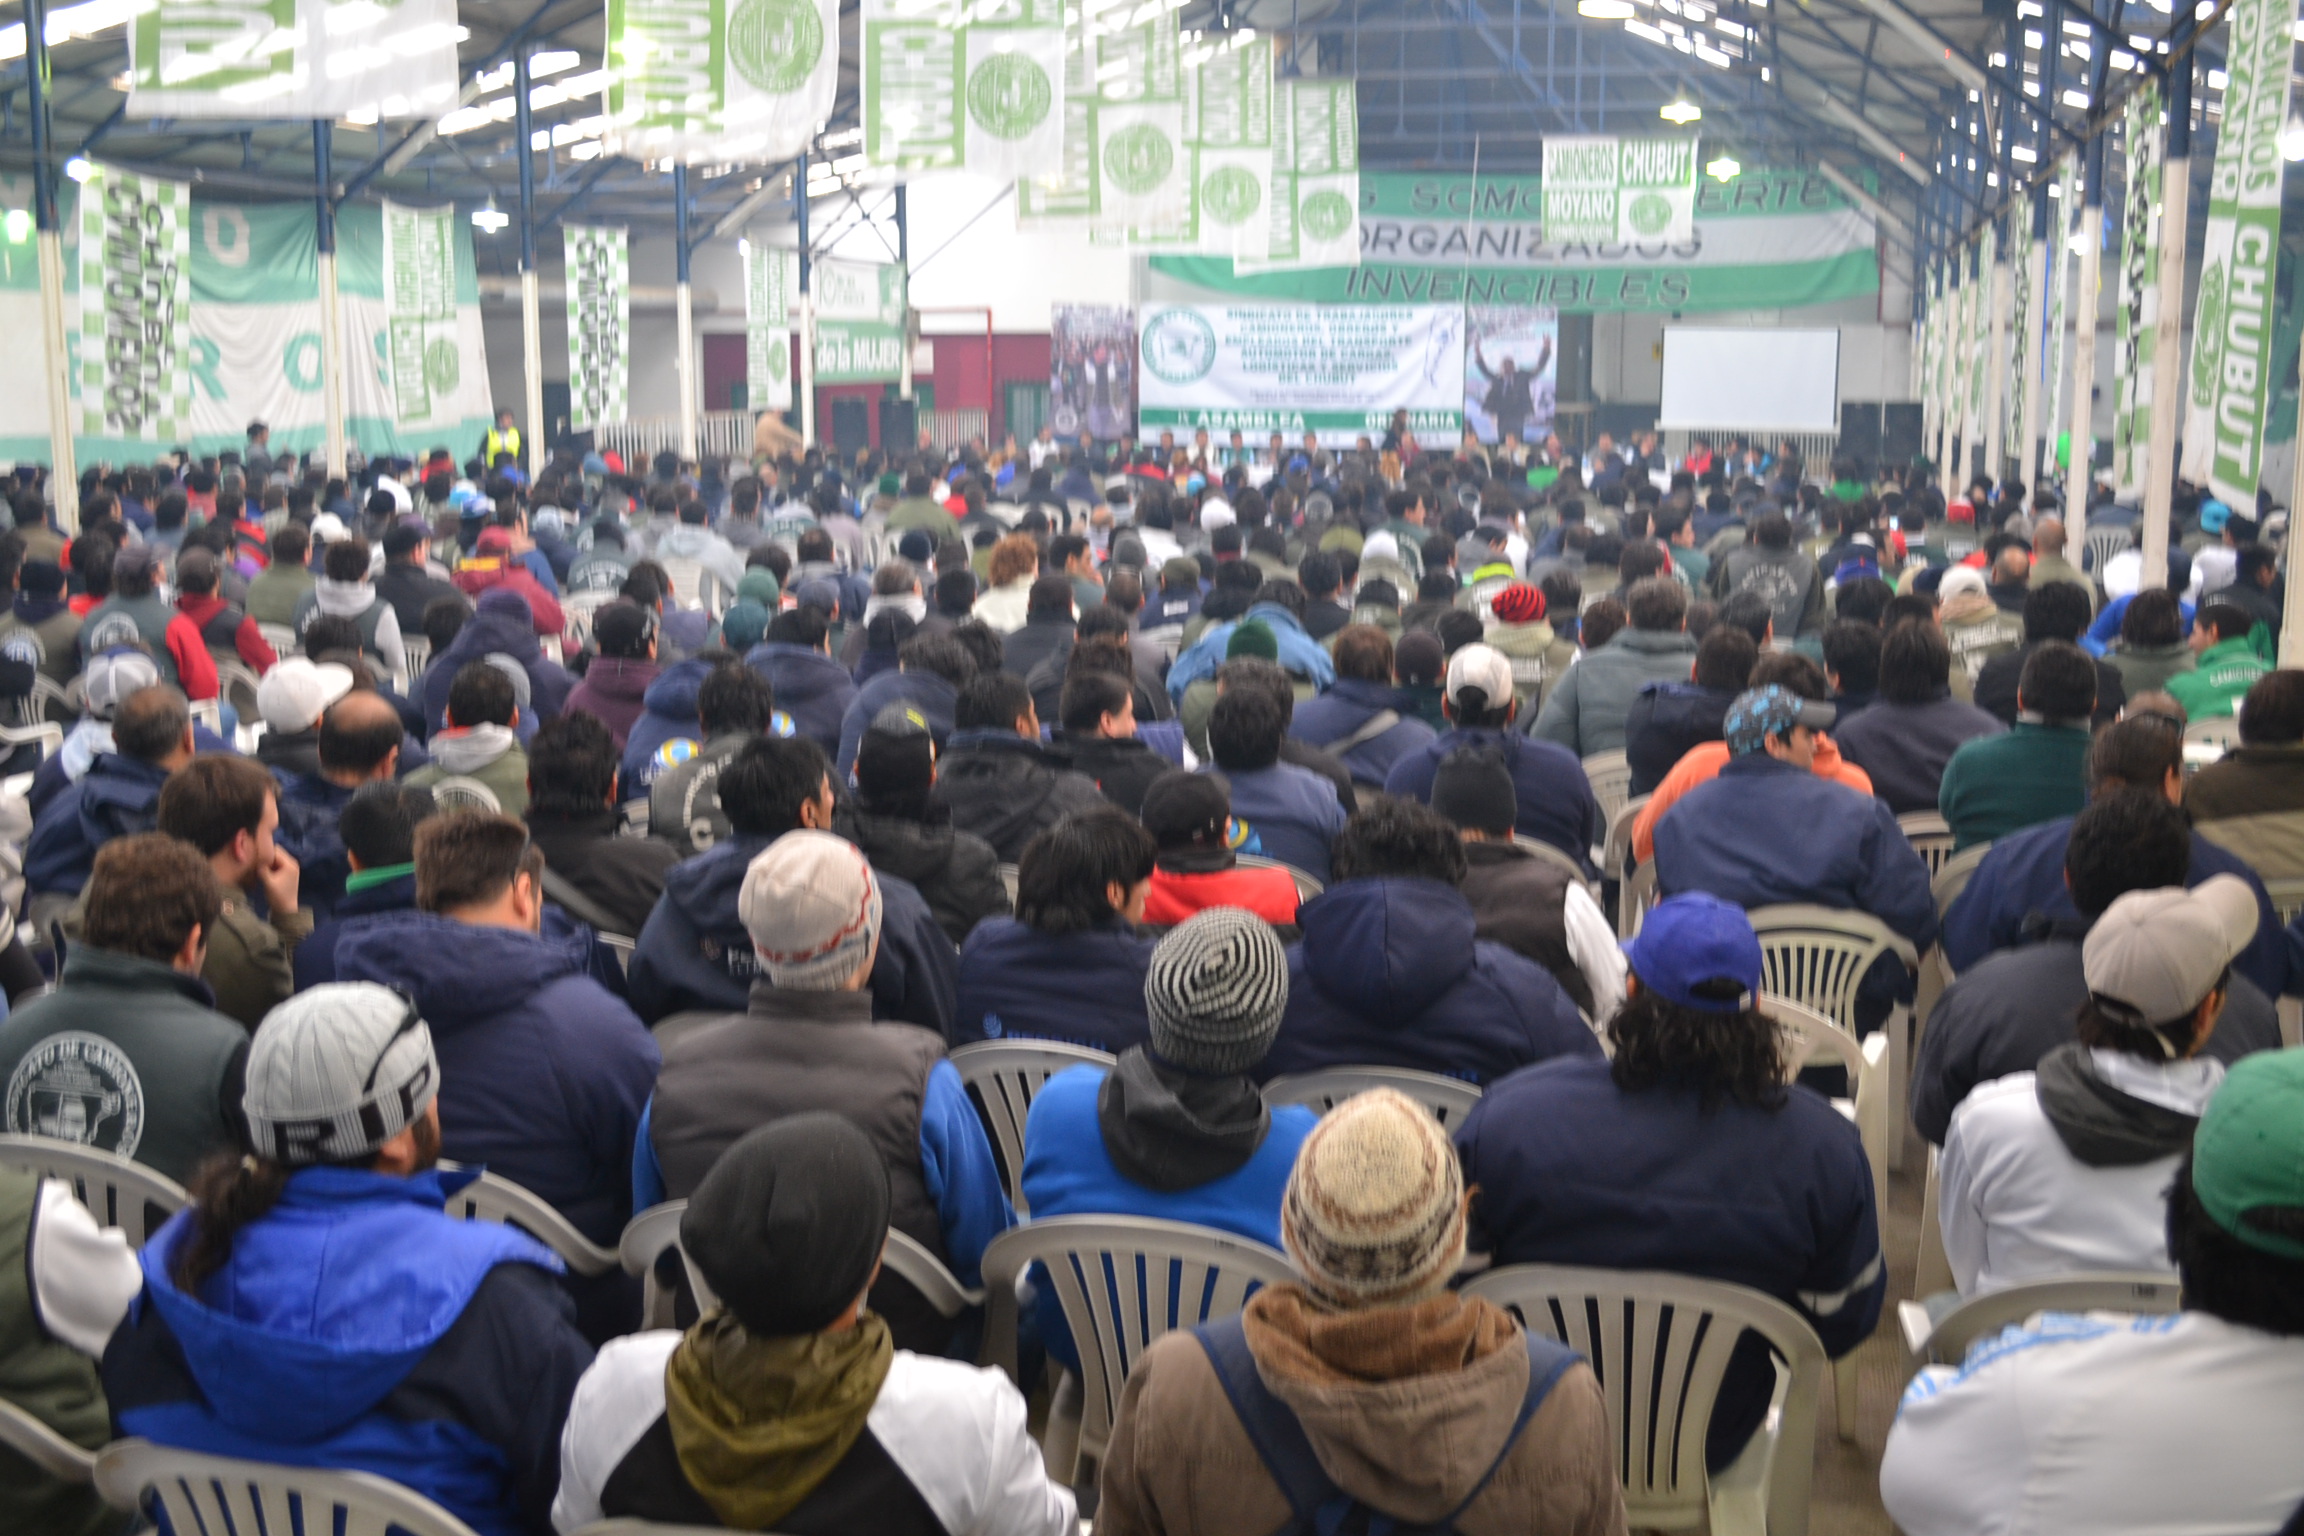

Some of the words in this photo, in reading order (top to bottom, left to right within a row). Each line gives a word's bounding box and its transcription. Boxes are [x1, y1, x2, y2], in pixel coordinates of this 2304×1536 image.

[2221, 4, 2259, 199] OYANO
[1549, 143, 1614, 181] CAMIONEROS
[1622, 140, 1688, 184] CHUBUT
[1410, 180, 1542, 216] SOMO
[1550, 190, 1614, 221] MOYANO
[1360, 223, 1702, 260] RGANIZS
[1346, 267, 1691, 309] INVENCIBLES
[853, 337, 900, 371] MUJER
[2217, 228, 2269, 479] CHUBUT
[1197, 409, 1305, 430] ASAMBLEA
[1365, 410, 1456, 430] ORNARIA
